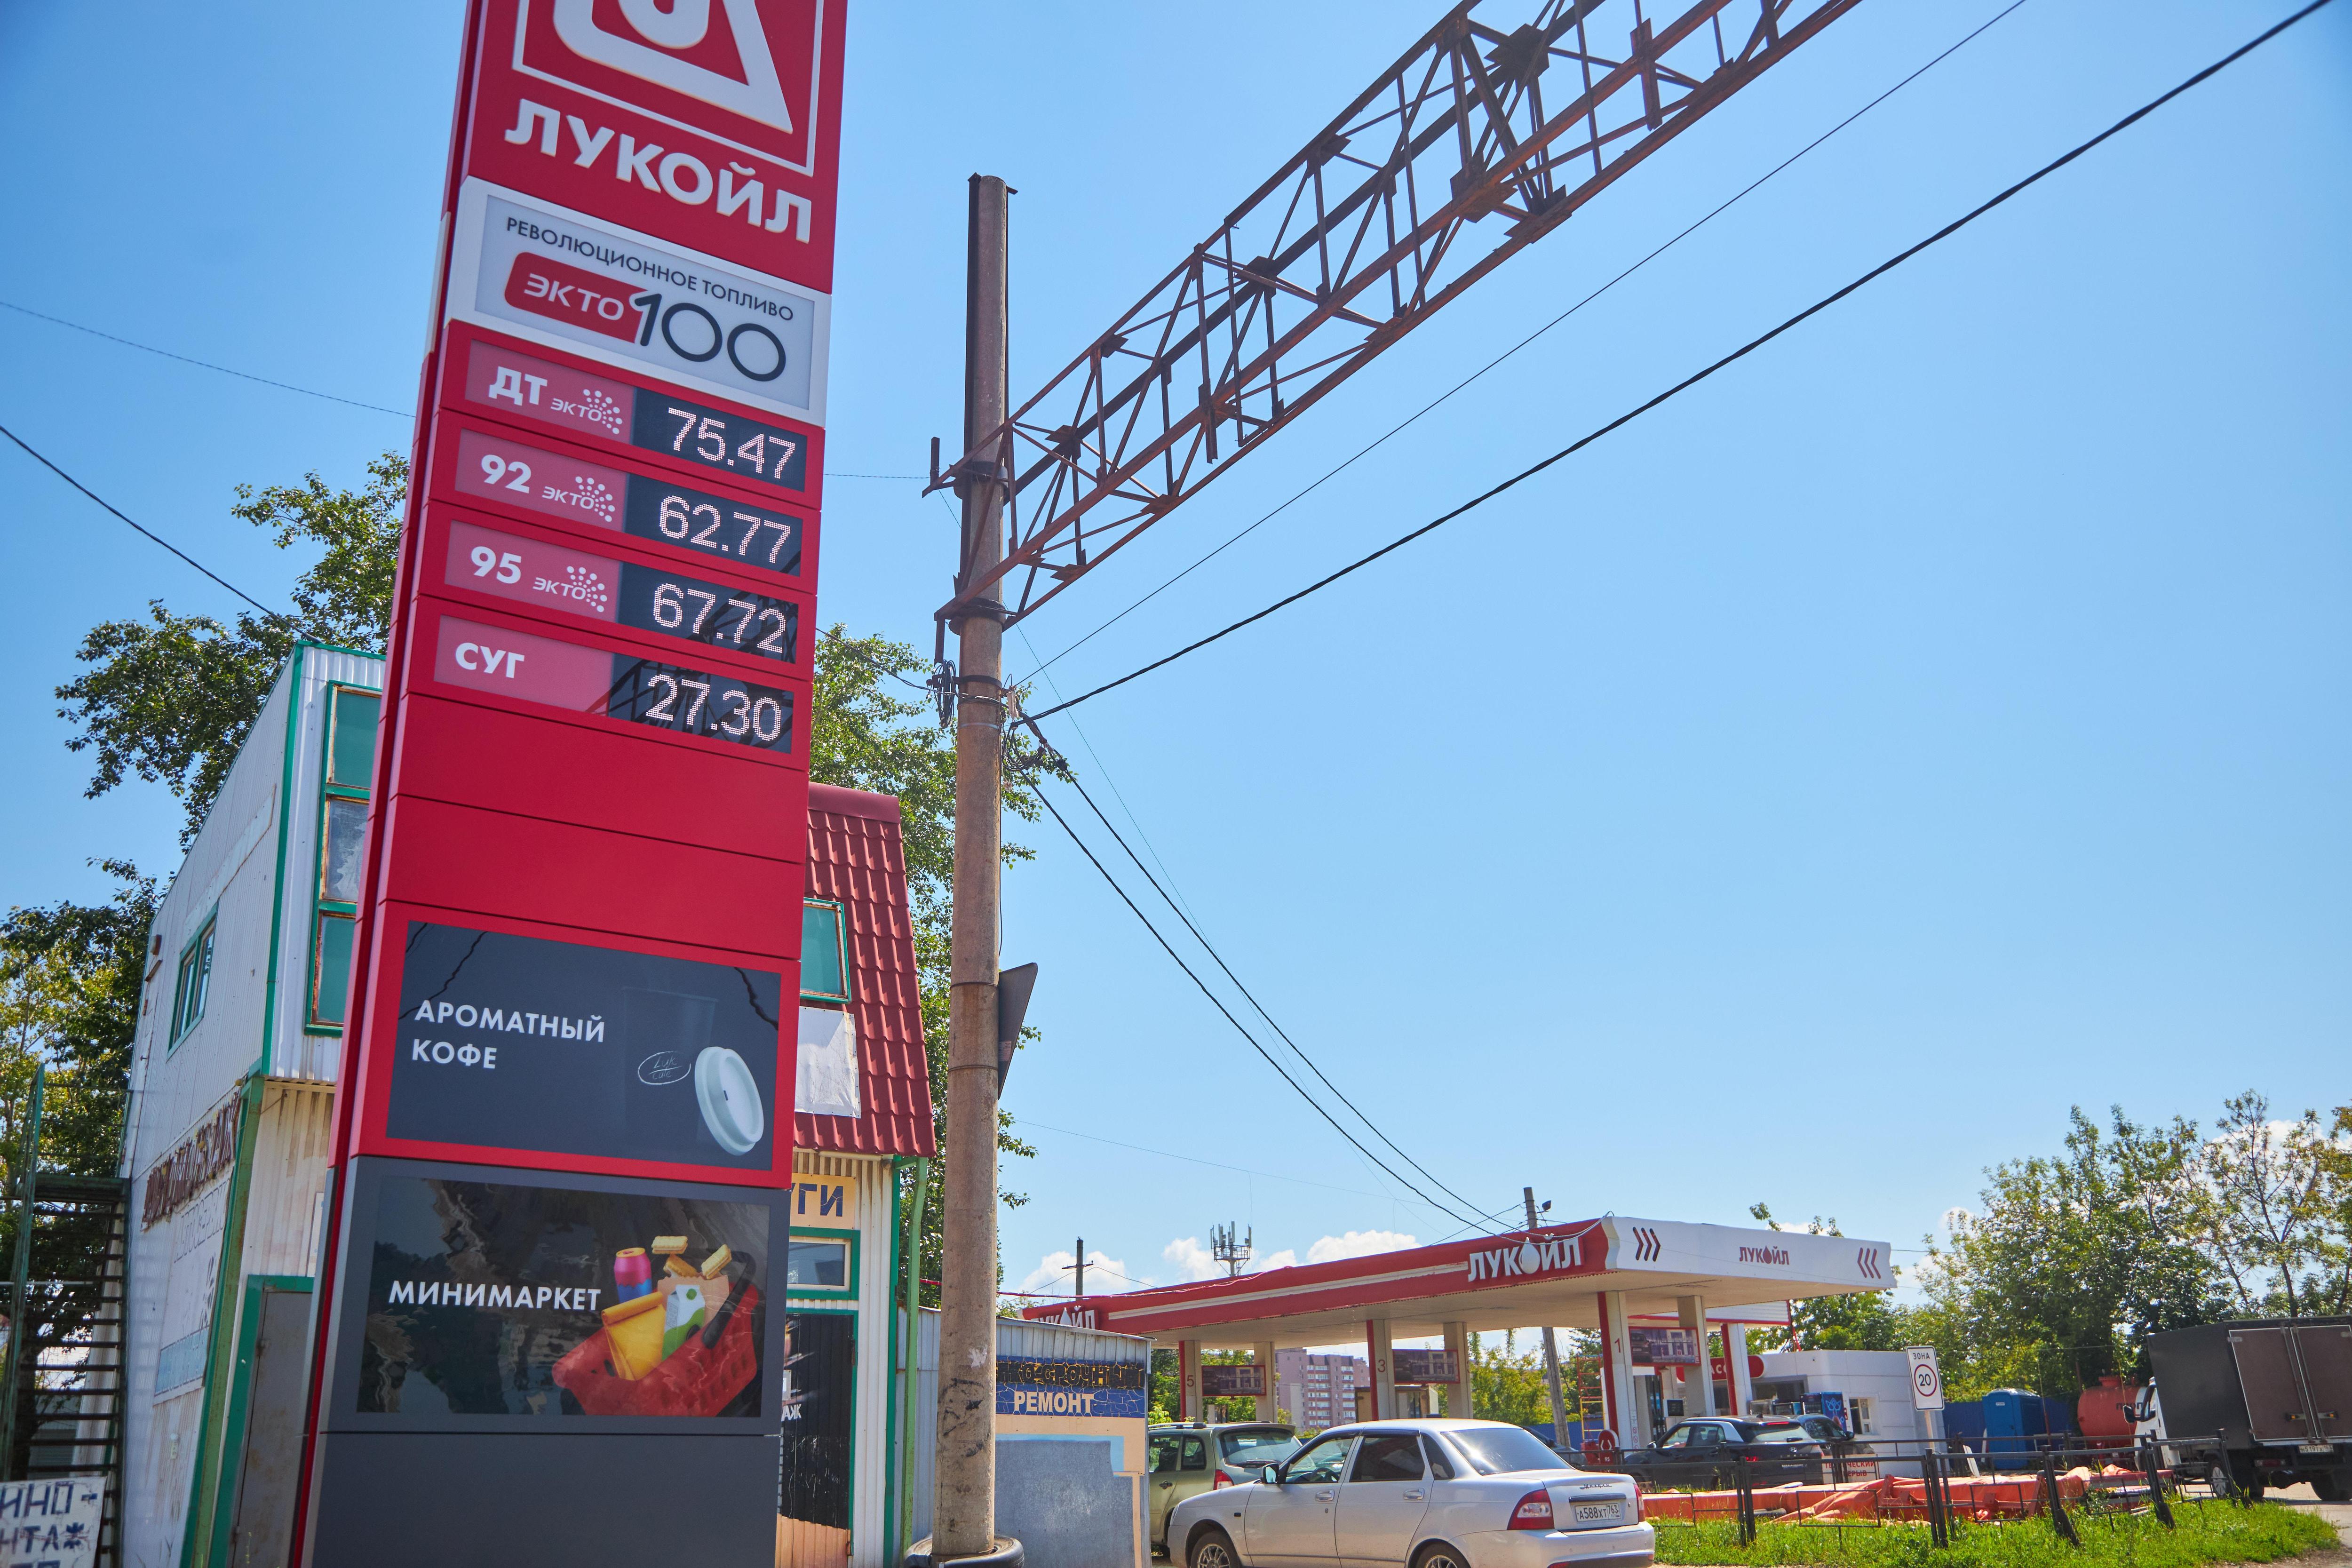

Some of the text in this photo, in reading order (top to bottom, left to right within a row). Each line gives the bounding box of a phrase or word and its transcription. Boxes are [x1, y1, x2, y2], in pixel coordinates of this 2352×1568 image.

[505, 98, 812, 244] ЛУКОЙЛ
[507, 216, 794, 321] РЕВОЛЮЦИОННОЕ ТОПЛИВО
[524, 273, 787, 382] ЭКТО 100
[488, 366, 796, 479] ДТ ЭКТО 75.47
[481, 455, 791, 564] 92 ЭКТО 62.77
[470, 547, 787, 654] 95 ЭКТО 67.72
[455, 643, 782, 742] СУГ 27.30
[414, 1000, 605, 1043] АРОМАТНЫЙ
[412, 1039, 497, 1069] КОФЕ
[791, 1183, 843, 1217] ГИ
[1468, 1233, 1581, 1282] ЛУКОЙЛ
[1740, 1245, 1789, 1265] ЛУКОЙЛ
[389, 1280, 601, 1311] МИНИМАРКЕТ
[1031, 1305, 1096, 1329] ОЙЛ
[1614, 1338, 1621, 1353] 1
[1186, 1375, 1194, 1387] 5
[1377, 1359, 1386, 1372] 3
[1919, 1374, 1931, 1386] 20
[1014, 1392, 1094, 1413] РЕМОНТ
[1580, 1505, 1619, 1520] А588ХТ 763
